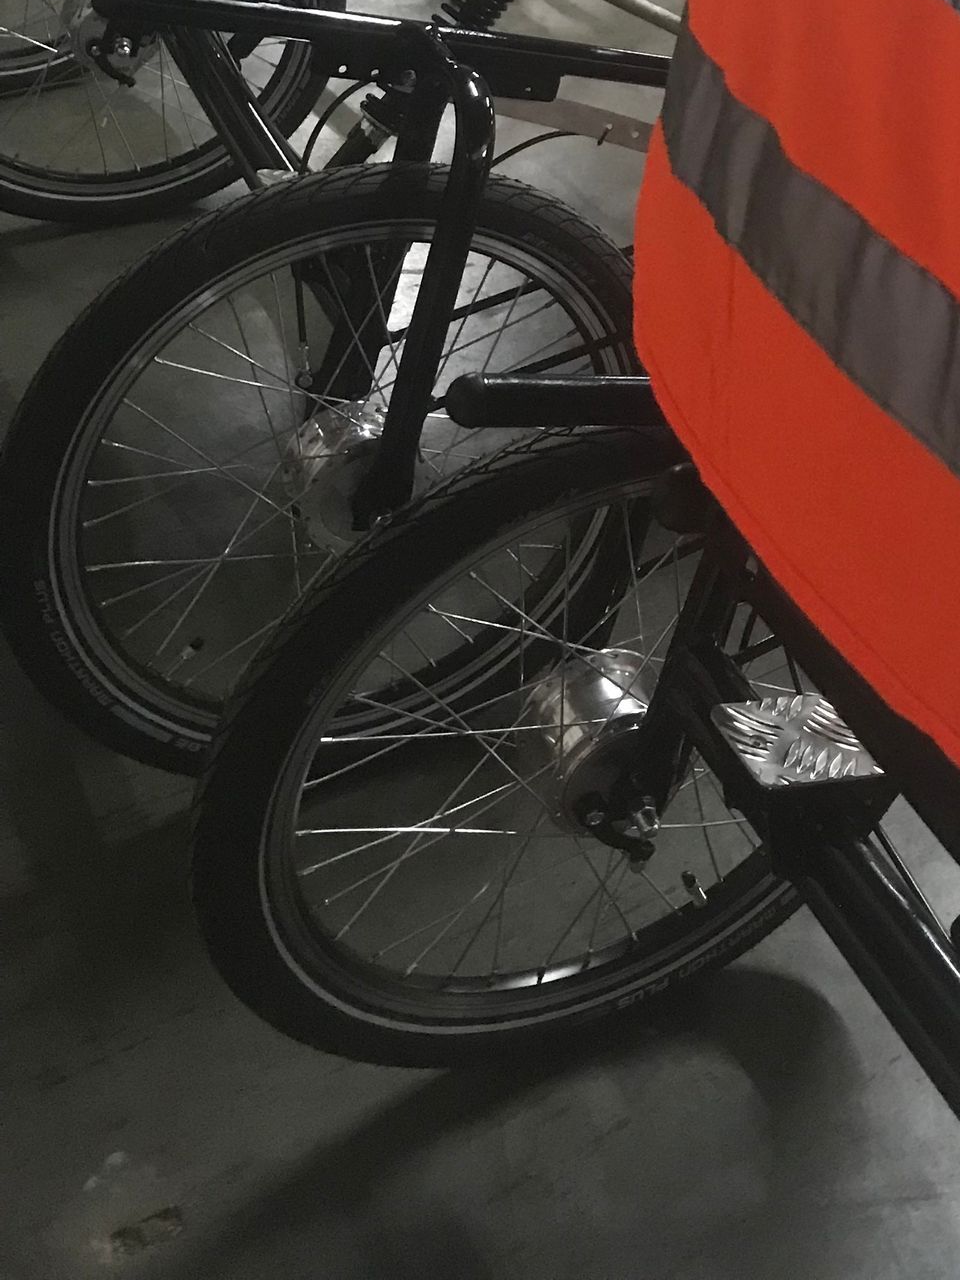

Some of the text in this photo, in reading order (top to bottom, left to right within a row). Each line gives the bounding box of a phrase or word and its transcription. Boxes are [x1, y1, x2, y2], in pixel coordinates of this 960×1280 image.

[33, 579, 113, 707] MARATHON PLUS
[616, 976, 670, 1010] PLUS
